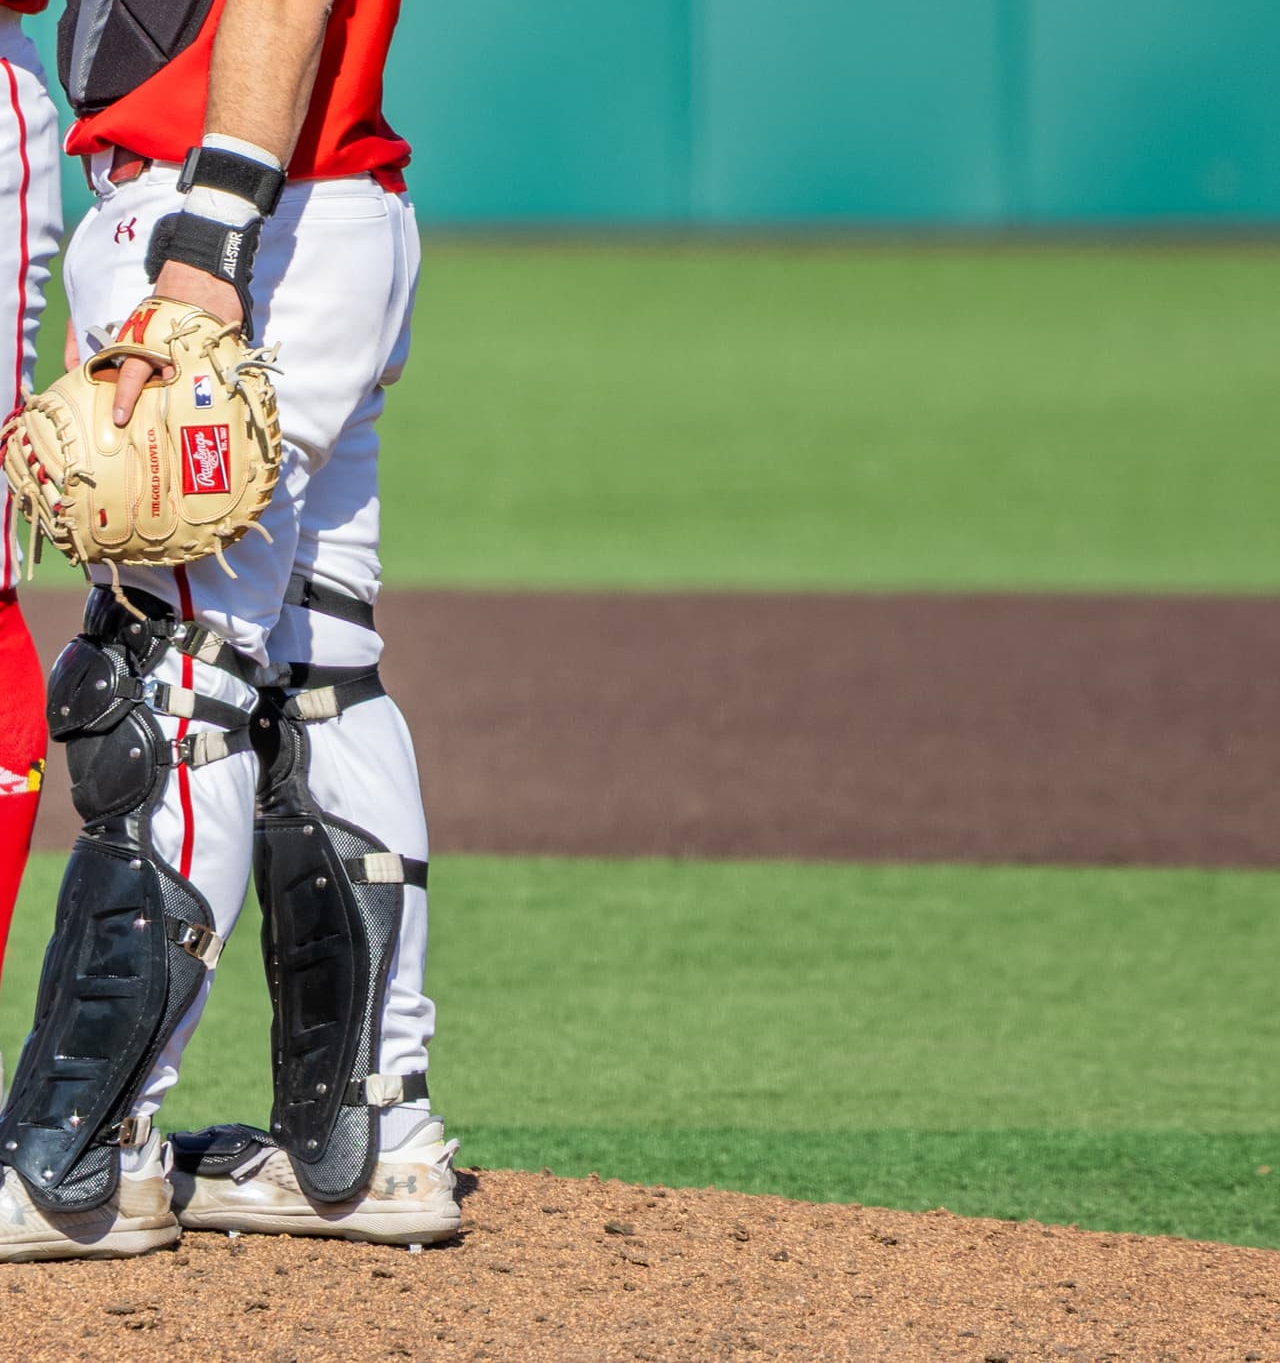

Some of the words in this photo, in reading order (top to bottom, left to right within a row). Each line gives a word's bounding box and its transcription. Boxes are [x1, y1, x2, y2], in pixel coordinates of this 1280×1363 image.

[223, 231, 244, 279] ALL-STAR
[115, 308, 158, 345] M
[149, 443, 160, 474] GLOVE
[193, 431, 216, 487] Rawlings
[151, 475, 161, 500] GOLD
[151, 501, 161, 518] THE
